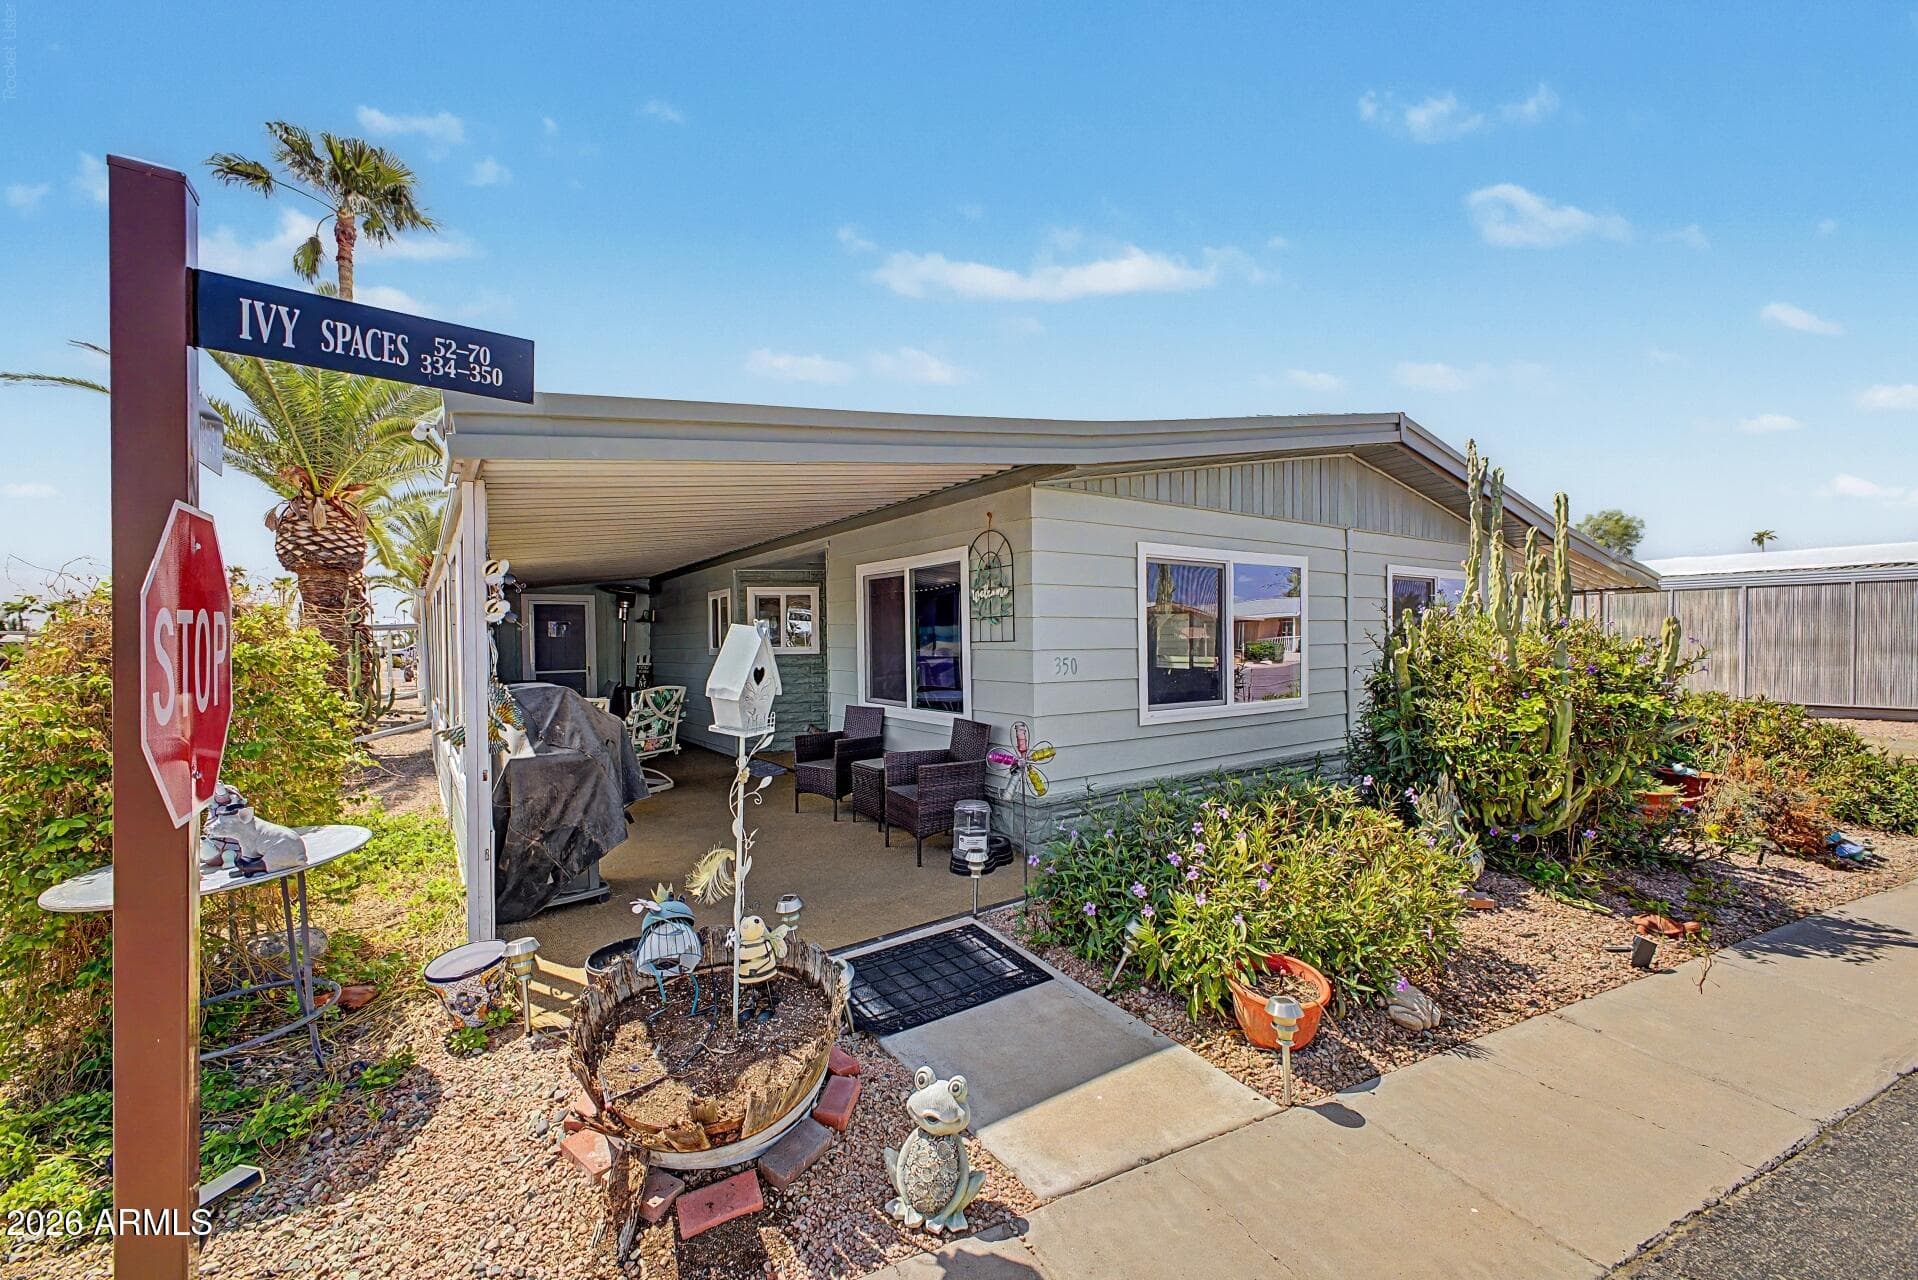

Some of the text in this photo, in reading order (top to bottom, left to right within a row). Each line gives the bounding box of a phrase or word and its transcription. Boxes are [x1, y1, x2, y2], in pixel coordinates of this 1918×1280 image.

[239, 298, 409, 367] IVY SPACES
[434, 337, 491, 367] 52-70
[420, 354, 503, 388] 334-350
[153, 606, 226, 726] STOP
[1054, 656, 1078, 676] 350
